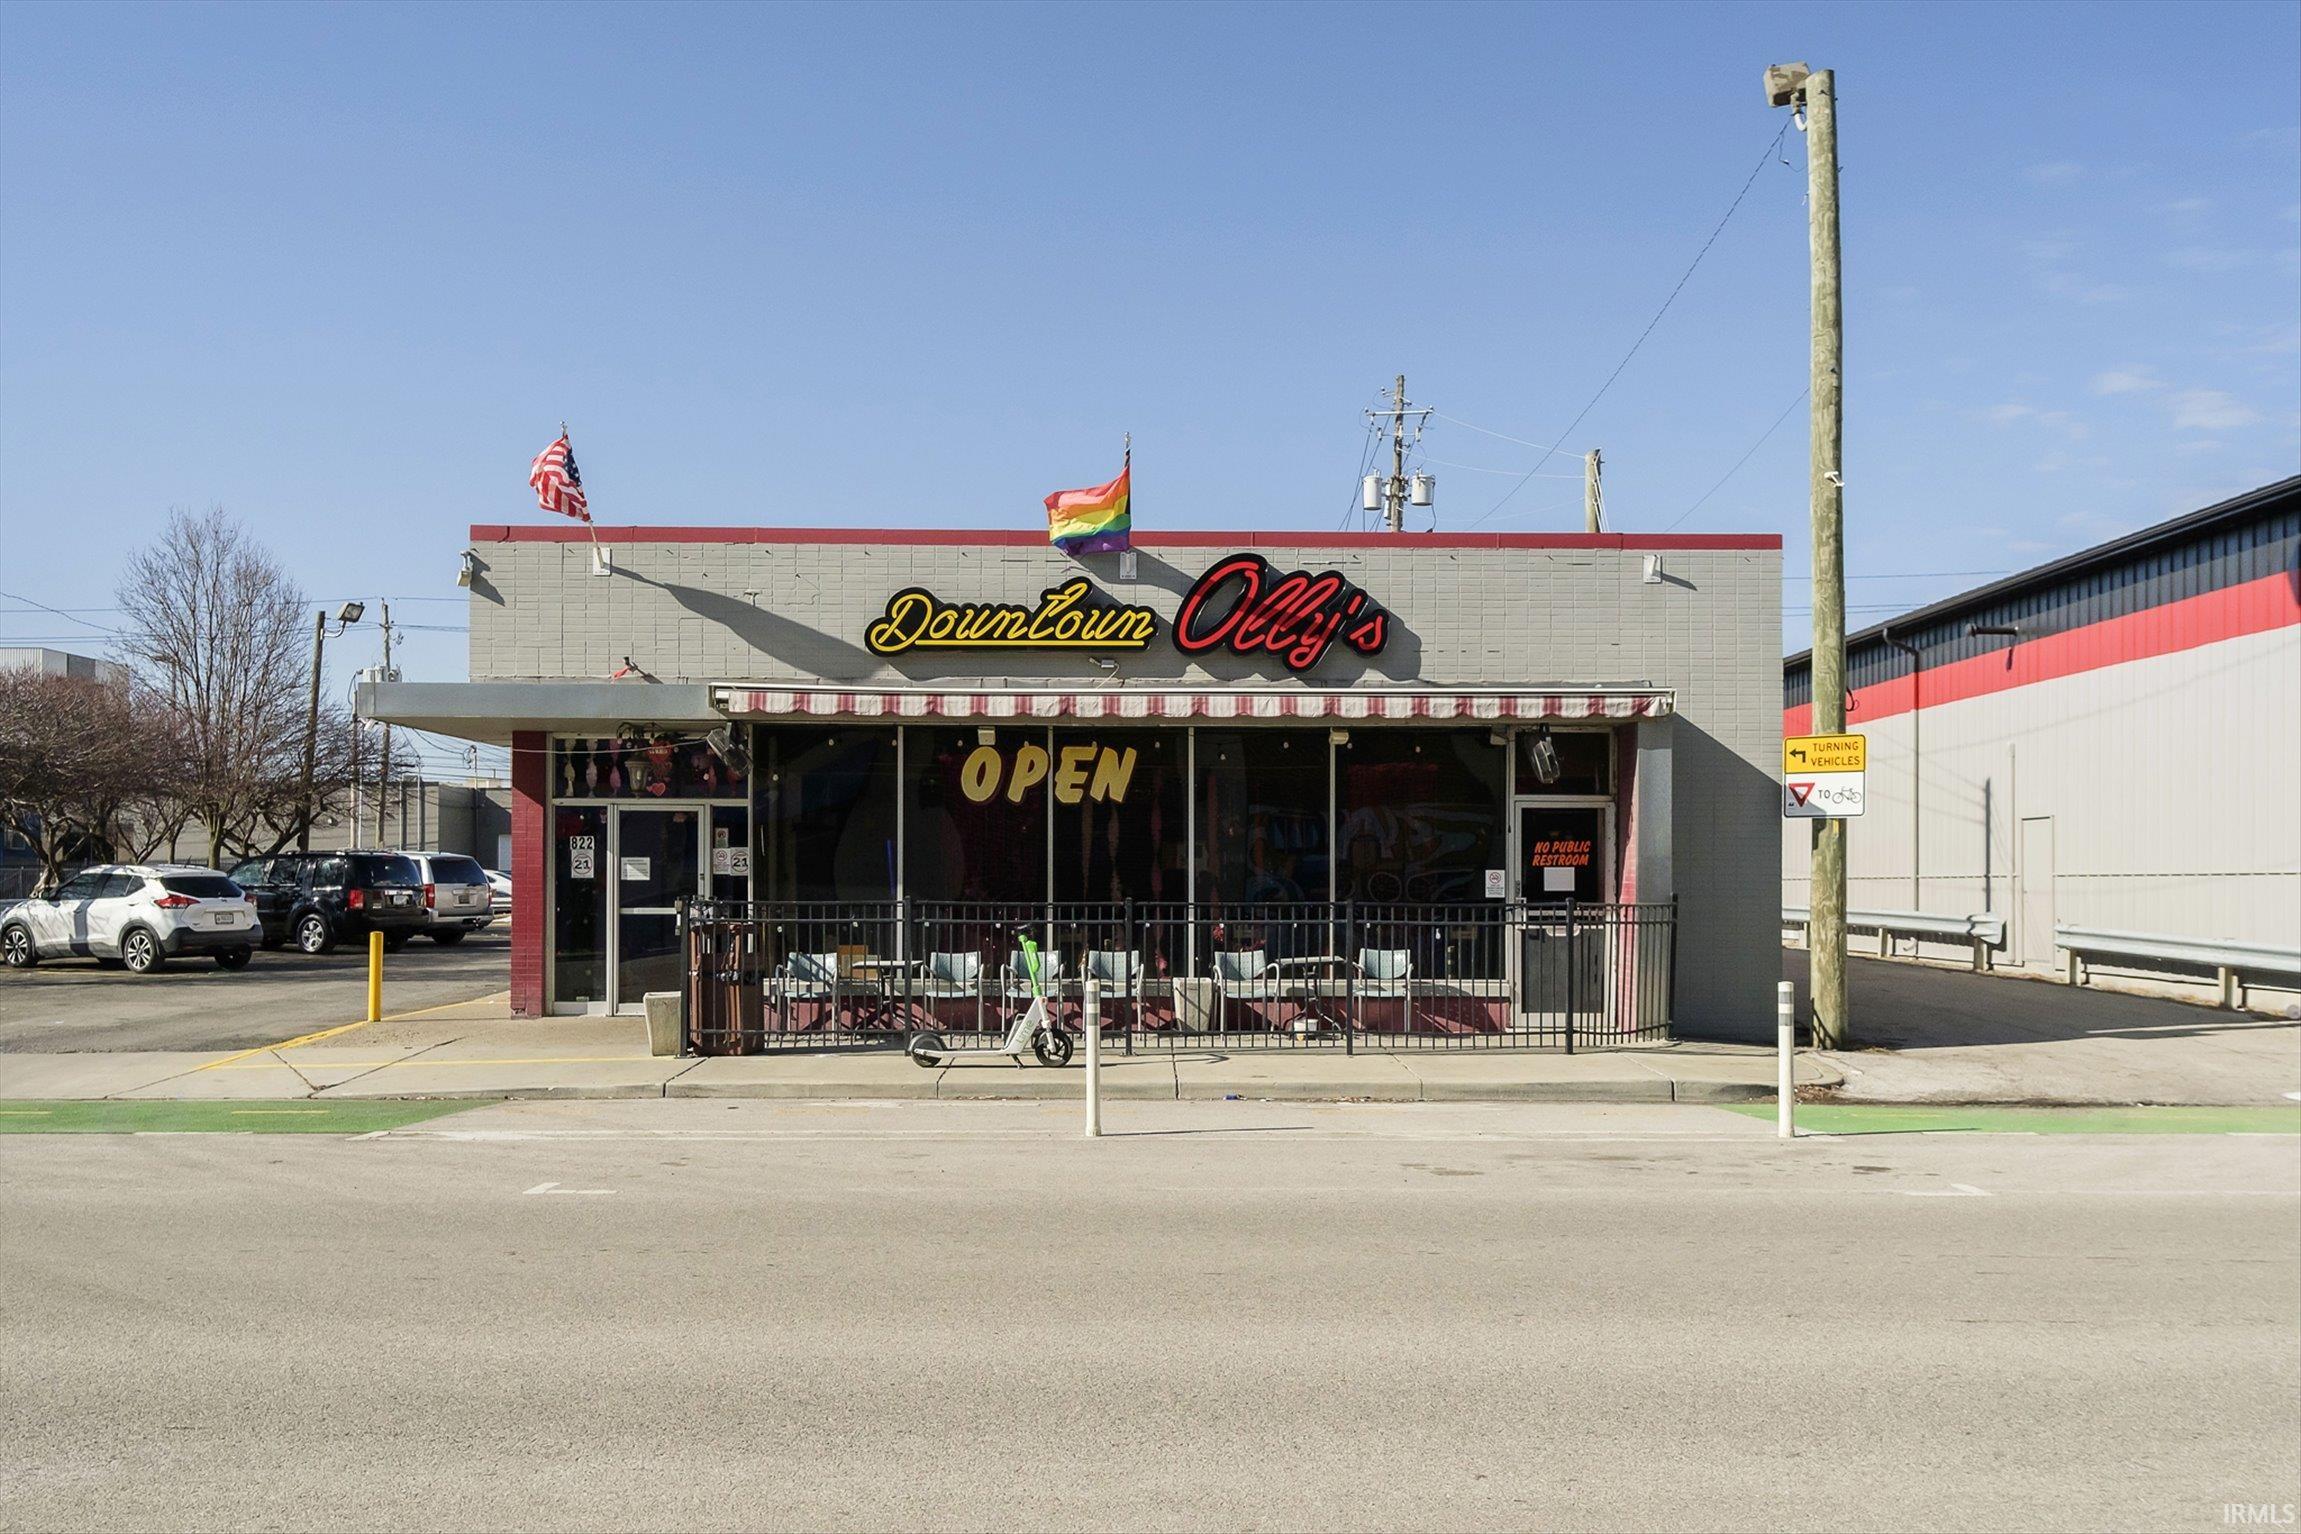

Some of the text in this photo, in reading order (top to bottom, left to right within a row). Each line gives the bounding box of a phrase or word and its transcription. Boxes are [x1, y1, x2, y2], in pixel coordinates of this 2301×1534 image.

[868, 559, 1385, 669] Downtown Olly's
[1812, 741, 1859, 752] TURNING
[1810, 755, 1861, 767] VEHICLES
[960, 745, 1138, 804] OPEN
[1817, 789, 1831, 799] TO
[571, 836, 593, 850] 822
[1534, 840, 1591, 853] NO PUBLIC
[574, 859, 590, 870] 21
[732, 857, 749, 867] 21
[1532, 854, 1589, 866] RESTROOM
